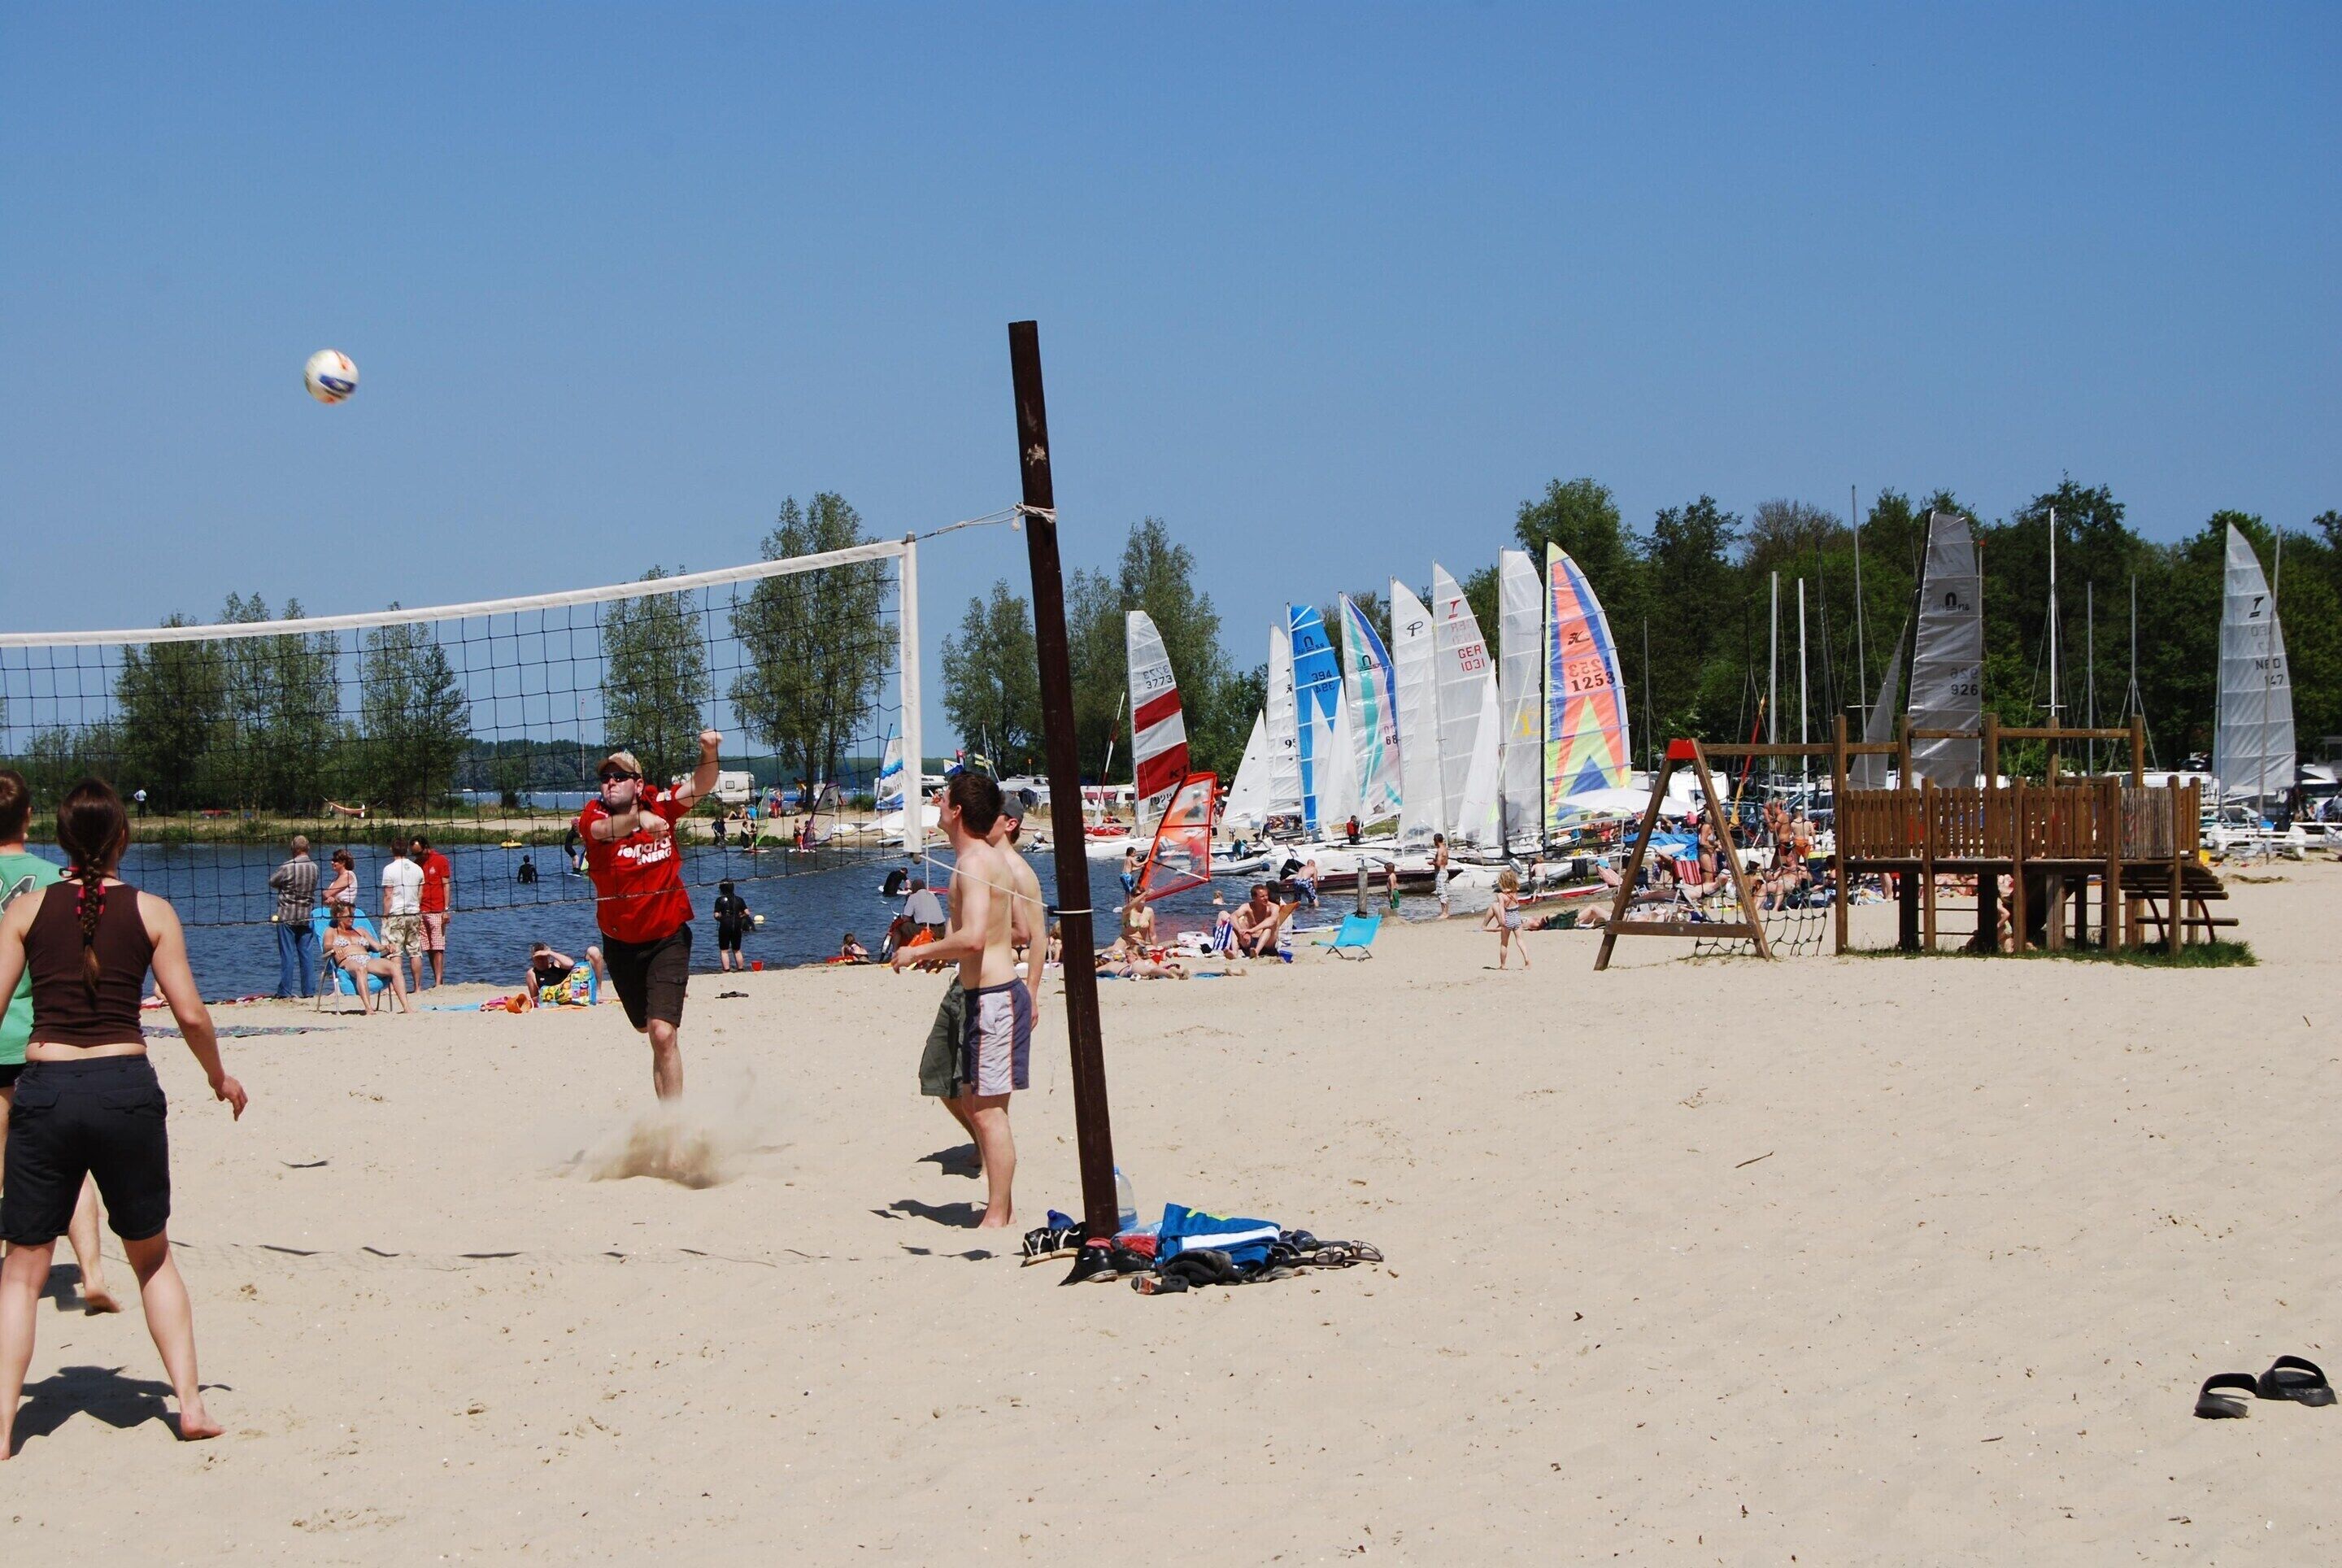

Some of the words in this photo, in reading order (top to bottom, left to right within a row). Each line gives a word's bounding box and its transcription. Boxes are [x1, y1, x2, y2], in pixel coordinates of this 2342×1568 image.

[1458, 644, 1482, 659] GER
[1461, 658, 1486, 672] 1031
[1146, 674, 1173, 689] 3773
[1311, 669, 1332, 682] 394
[1571, 671, 1616, 692] 1253
[1951, 684, 1979, 696] 926
[1386, 734, 1398, 746] 68
